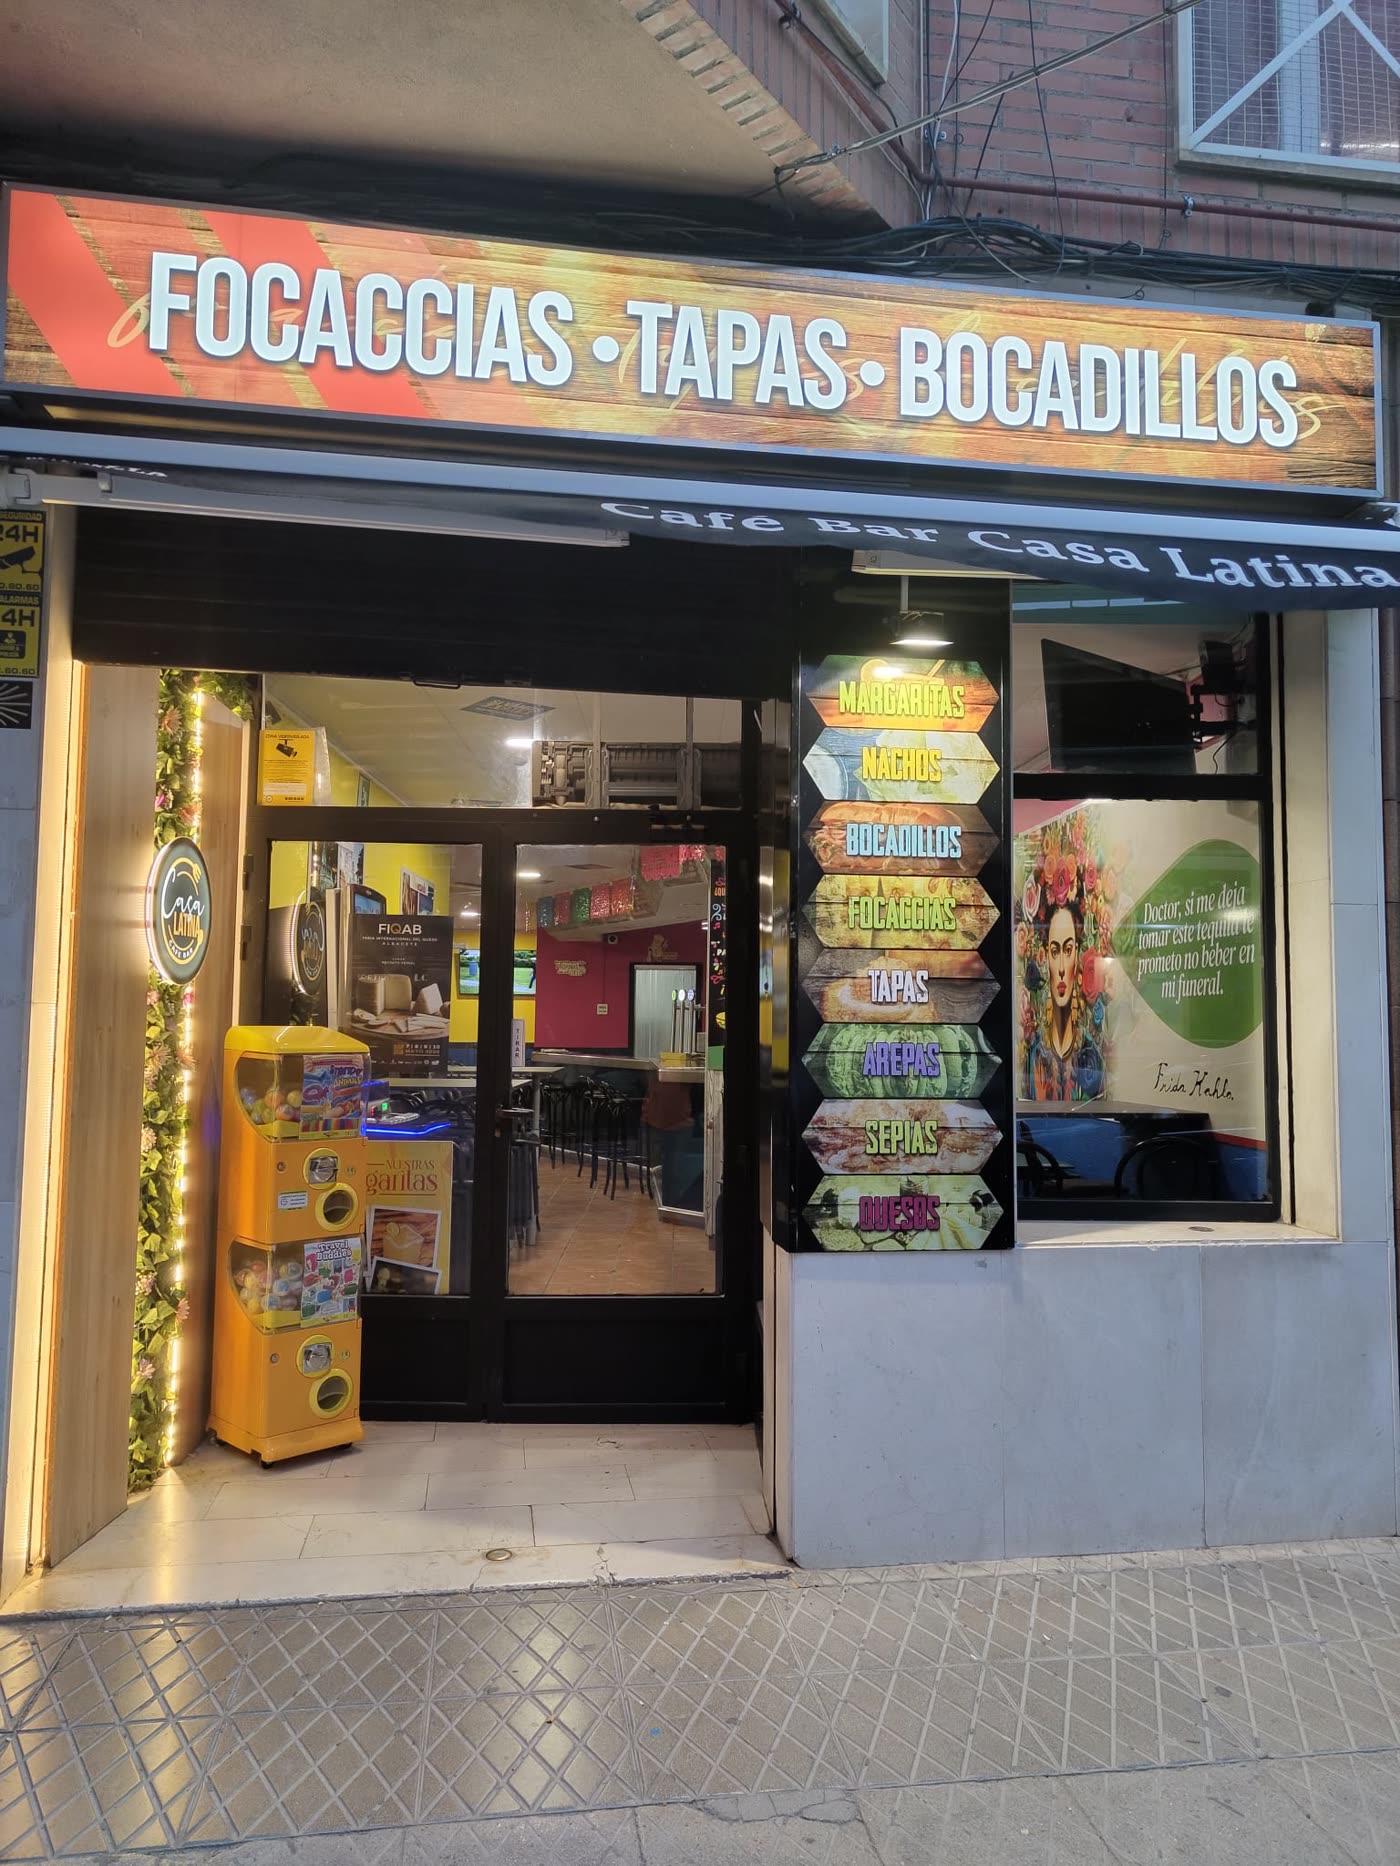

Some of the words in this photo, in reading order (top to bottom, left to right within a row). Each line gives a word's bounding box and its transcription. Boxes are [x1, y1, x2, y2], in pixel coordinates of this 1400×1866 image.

[149, 252, 573, 386] FOCACCIAS
[627, 300, 847, 410] TAPAS
[900, 327, 1299, 447] BOCADILLOS
[0, 524, 39, 543] 4H
[808, 517, 939, 542] Bar
[967, 530, 1150, 573] Casa
[1160, 547, 1400, 588] Latina
[839, 681, 966, 718] MARGARITAS
[862, 747, 943, 782] NACHOS
[846, 823, 963, 859] BOCADILLOS
[161, 867, 205, 922] Casa
[1144, 900, 1181, 924] Doctor,
[1184, 891, 1194, 917] si
[1196, 892, 1216, 914] me
[1217, 880, 1246, 911] deja
[173, 911, 200, 938] LATINA
[378, 922, 422, 935] FIQAB
[848, 896, 957, 931] FOCACCIAS
[1138, 929, 1171, 950] tomar
[1172, 922, 1195, 945] este
[1138, 951, 1182, 982] prometo
[1184, 950, 1199, 971] no
[1201, 941, 1237, 969] beber
[1239, 943, 1255, 965] en
[868, 969, 930, 1003] TAPAS
[1161, 974, 1176, 998] mi
[1175, 970, 1224, 1005] funeral.
[862, 1042, 941, 1077] AREPAS
[1154, 1062, 1186, 1093] Frida
[865, 1119, 938, 1154] SEPIAS
[386, 1159, 435, 1170] NUESTRAS
[859, 1195, 941, 1231] QUESOS
[315, 1248, 352, 1262] Buddies
[318, 1240, 349, 1252] Travel
